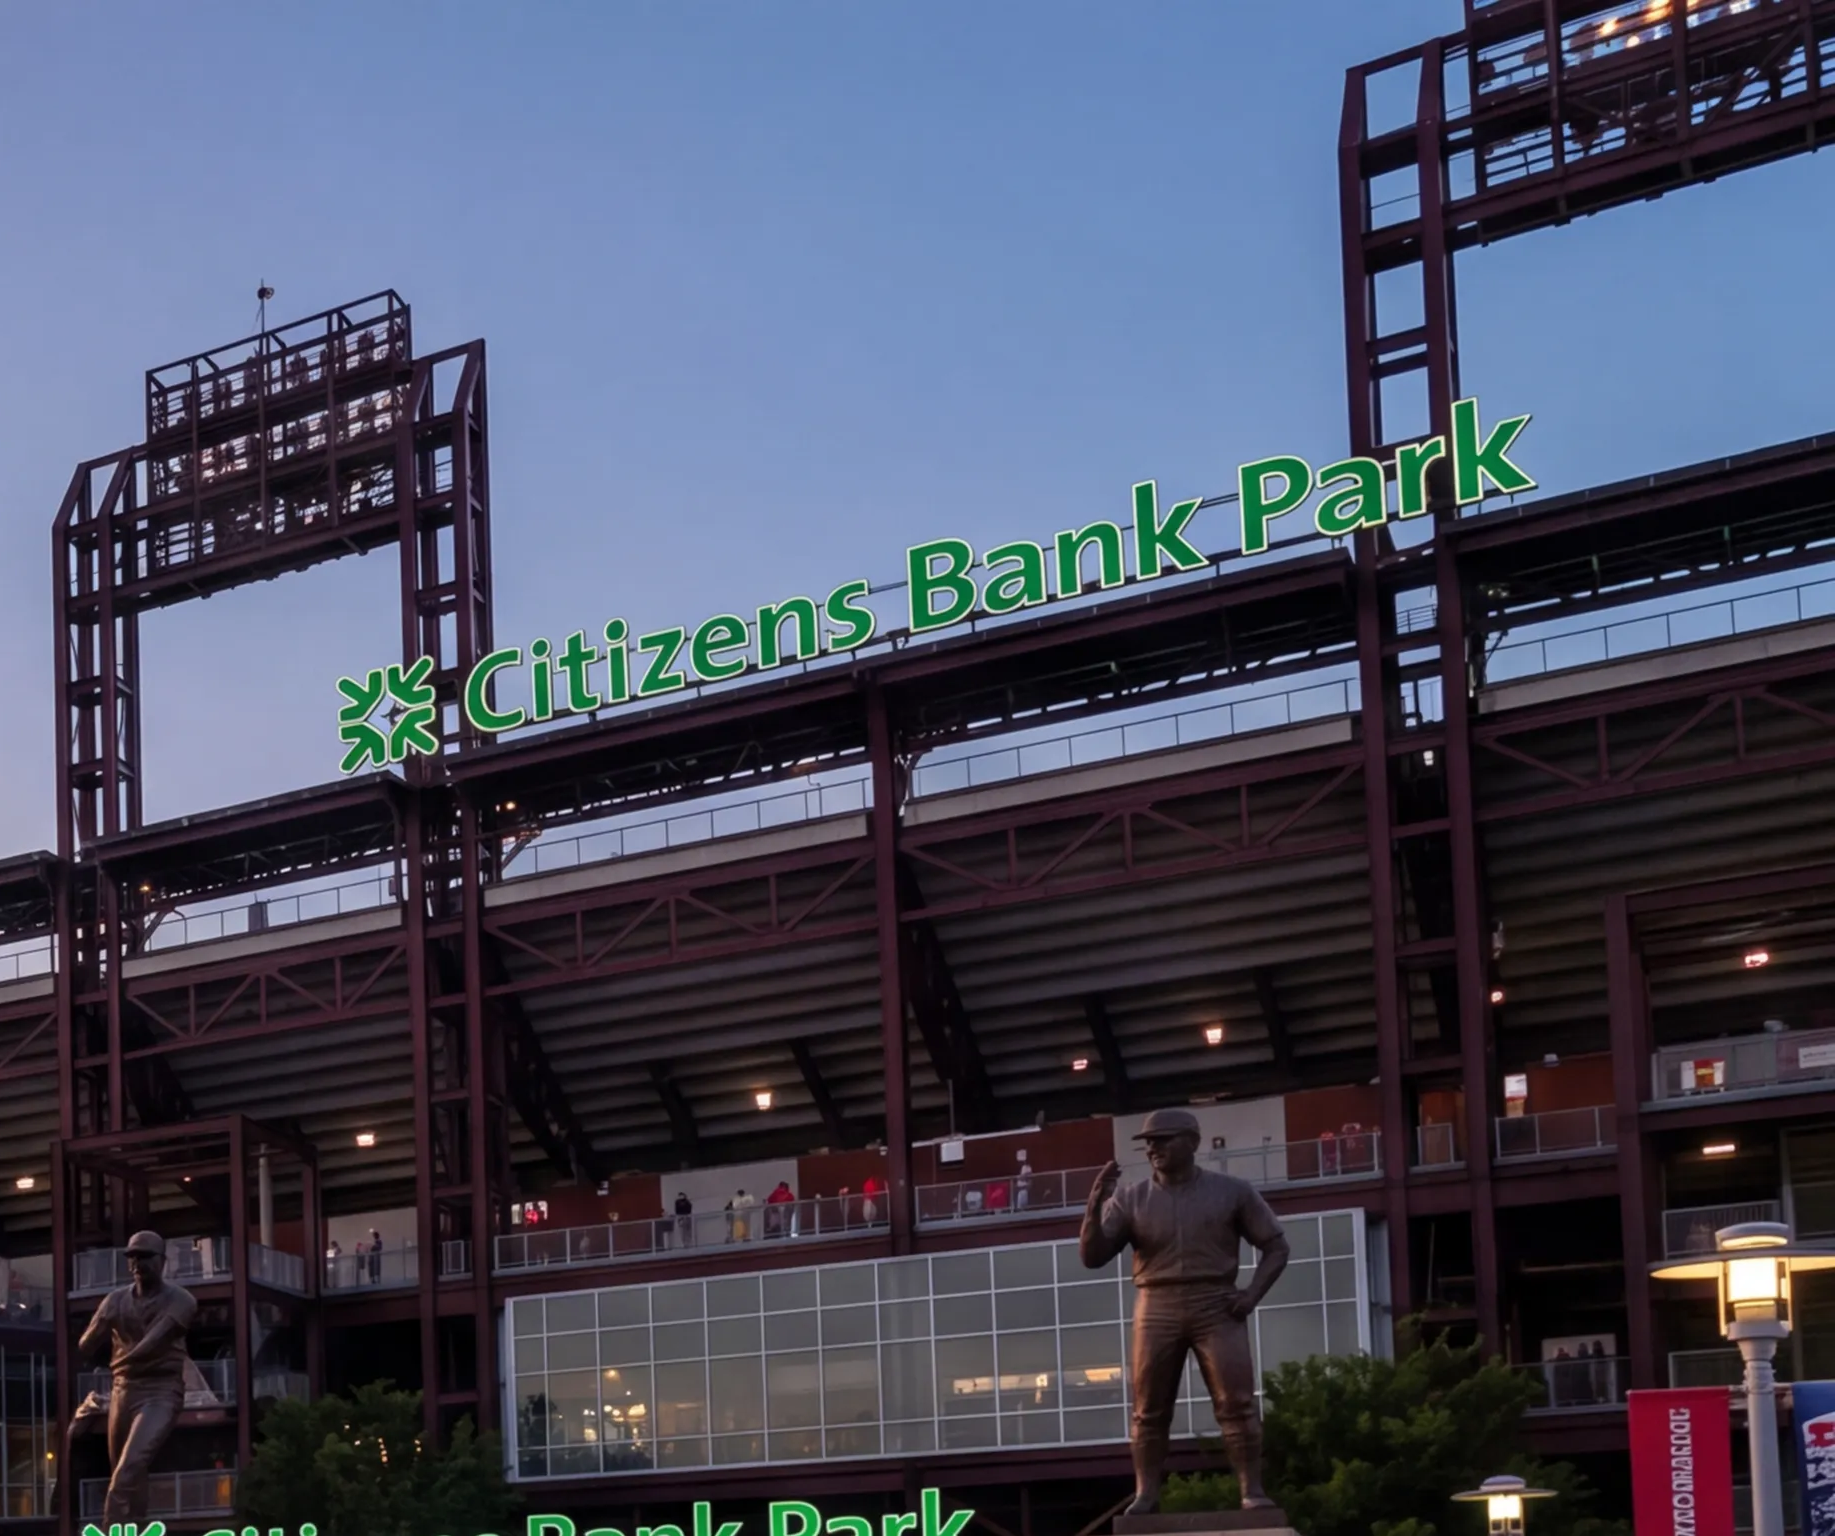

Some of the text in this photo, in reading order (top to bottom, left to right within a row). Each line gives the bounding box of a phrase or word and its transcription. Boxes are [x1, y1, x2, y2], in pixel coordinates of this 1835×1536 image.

[465, 397, 1538, 734] Citizens Bank Park
